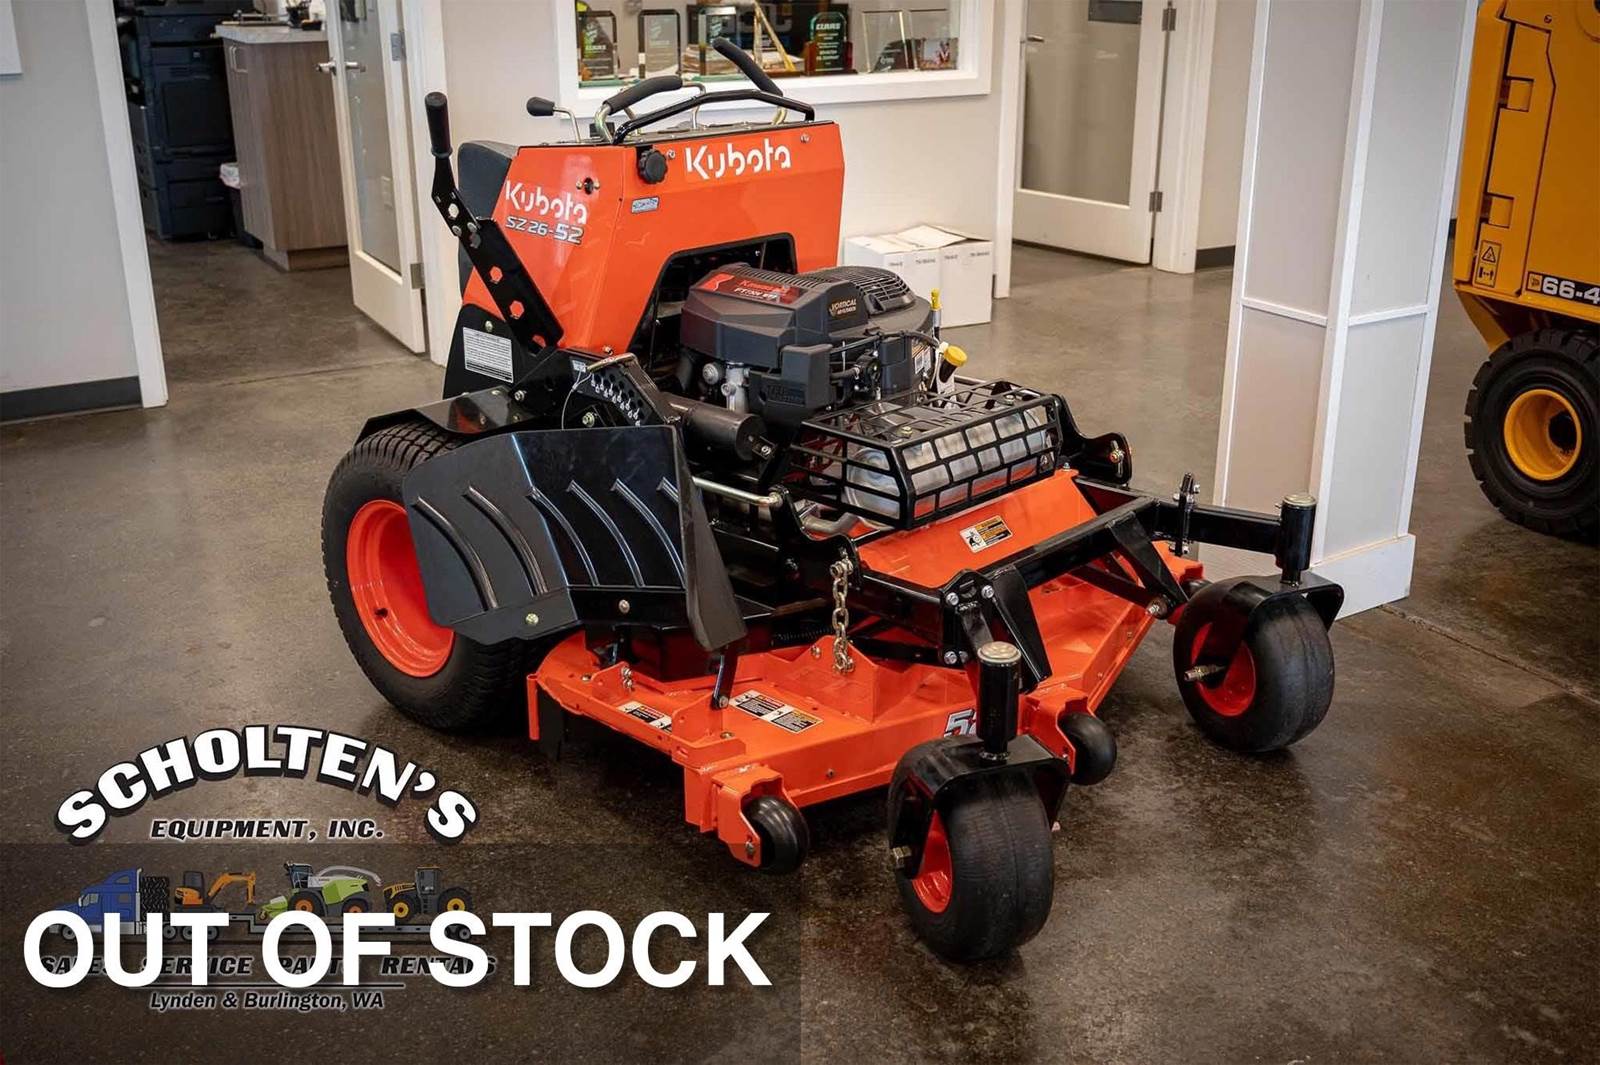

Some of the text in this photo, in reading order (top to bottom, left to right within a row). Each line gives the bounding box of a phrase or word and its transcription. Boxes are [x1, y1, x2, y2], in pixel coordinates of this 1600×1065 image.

[685, 138, 792, 180] Kubota
[505, 180, 588, 225] Kubota
[943, 708, 977, 737] 5
